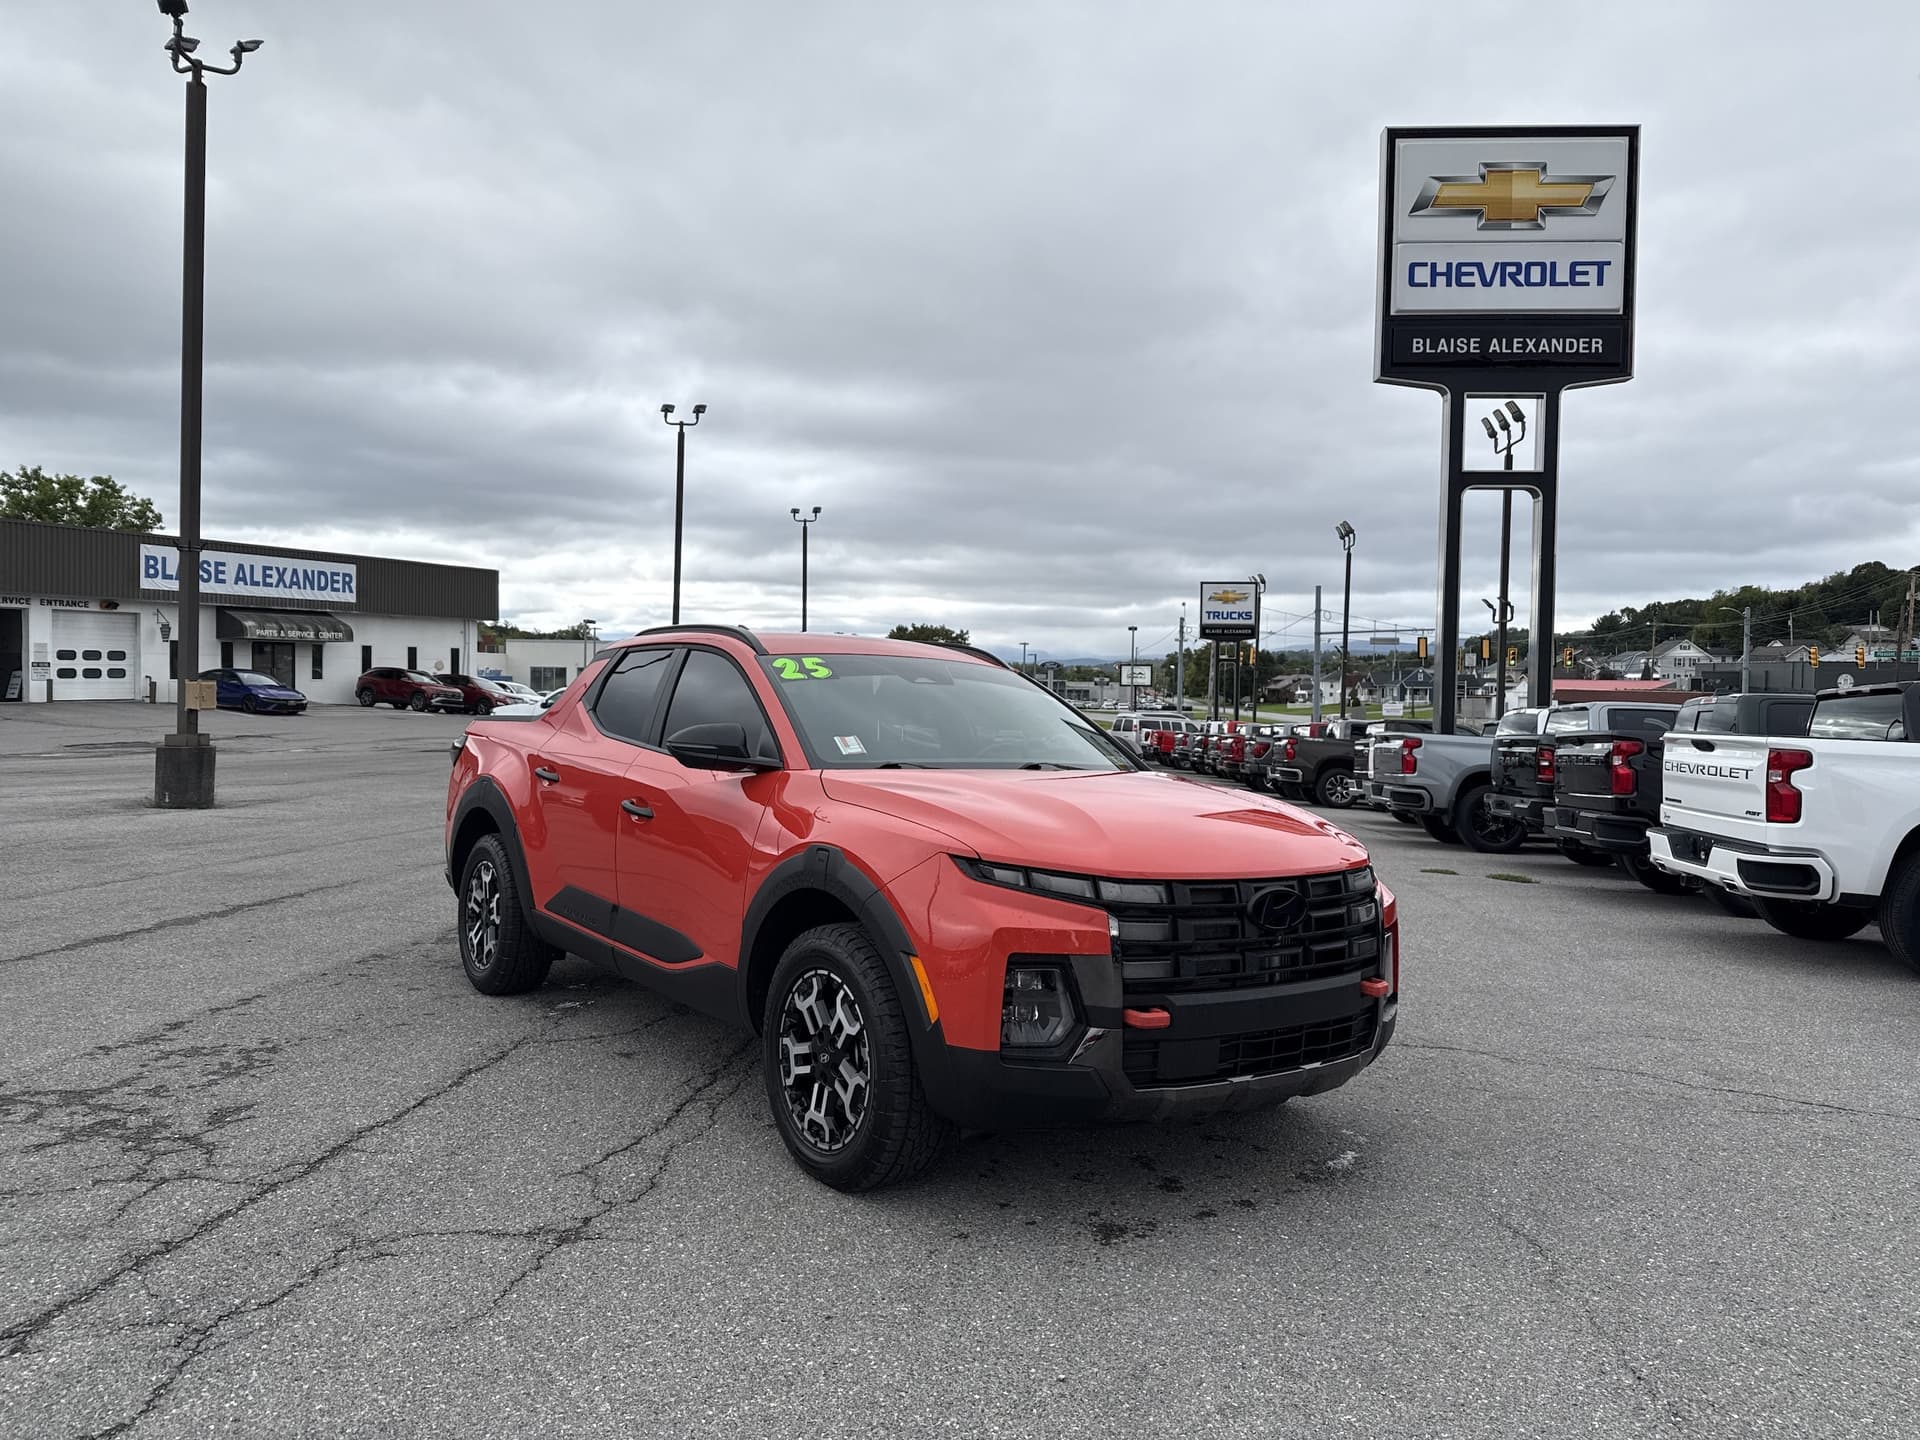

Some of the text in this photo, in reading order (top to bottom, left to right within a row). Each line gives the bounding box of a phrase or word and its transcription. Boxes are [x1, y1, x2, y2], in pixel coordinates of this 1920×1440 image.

[1407, 260, 1611, 288] CHEVROLET
[1411, 337, 1604, 353] BLAISE ALEXANDER
[144, 554, 354, 594] BLSE ALEXANDER
[0, 596, 89, 609] RVICE ENTRANCE
[1205, 610, 1253, 620] TRUCKS
[256, 629, 278, 637] PARTS
[287, 630, 315, 638] SERVICE
[319, 632, 343, 640] CENTER
[772, 657, 833, 680] 25
[1664, 760, 1754, 780] CHEVROLET
